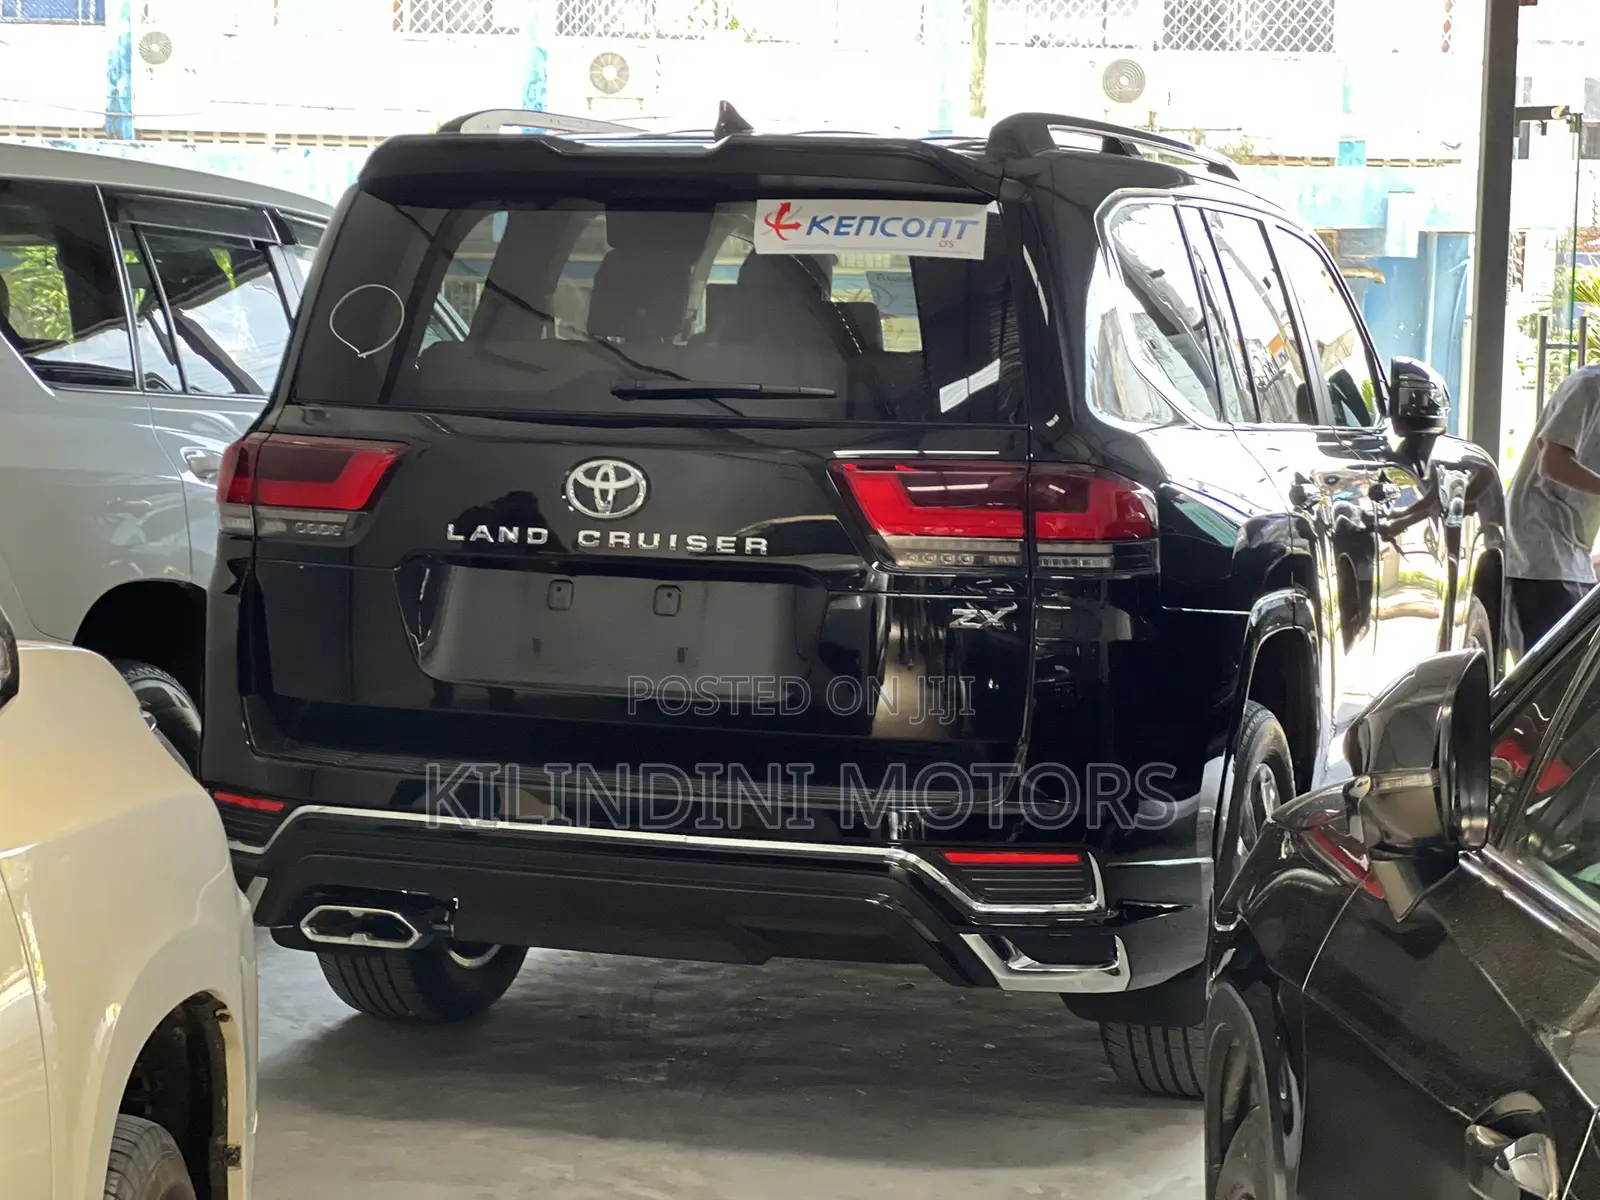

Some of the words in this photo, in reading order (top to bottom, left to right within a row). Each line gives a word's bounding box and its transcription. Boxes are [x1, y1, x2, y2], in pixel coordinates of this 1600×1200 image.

[446, 523, 549, 545] LAND
[577, 529, 768, 555] CRUISER
[949, 601, 1018, 629] ZX
